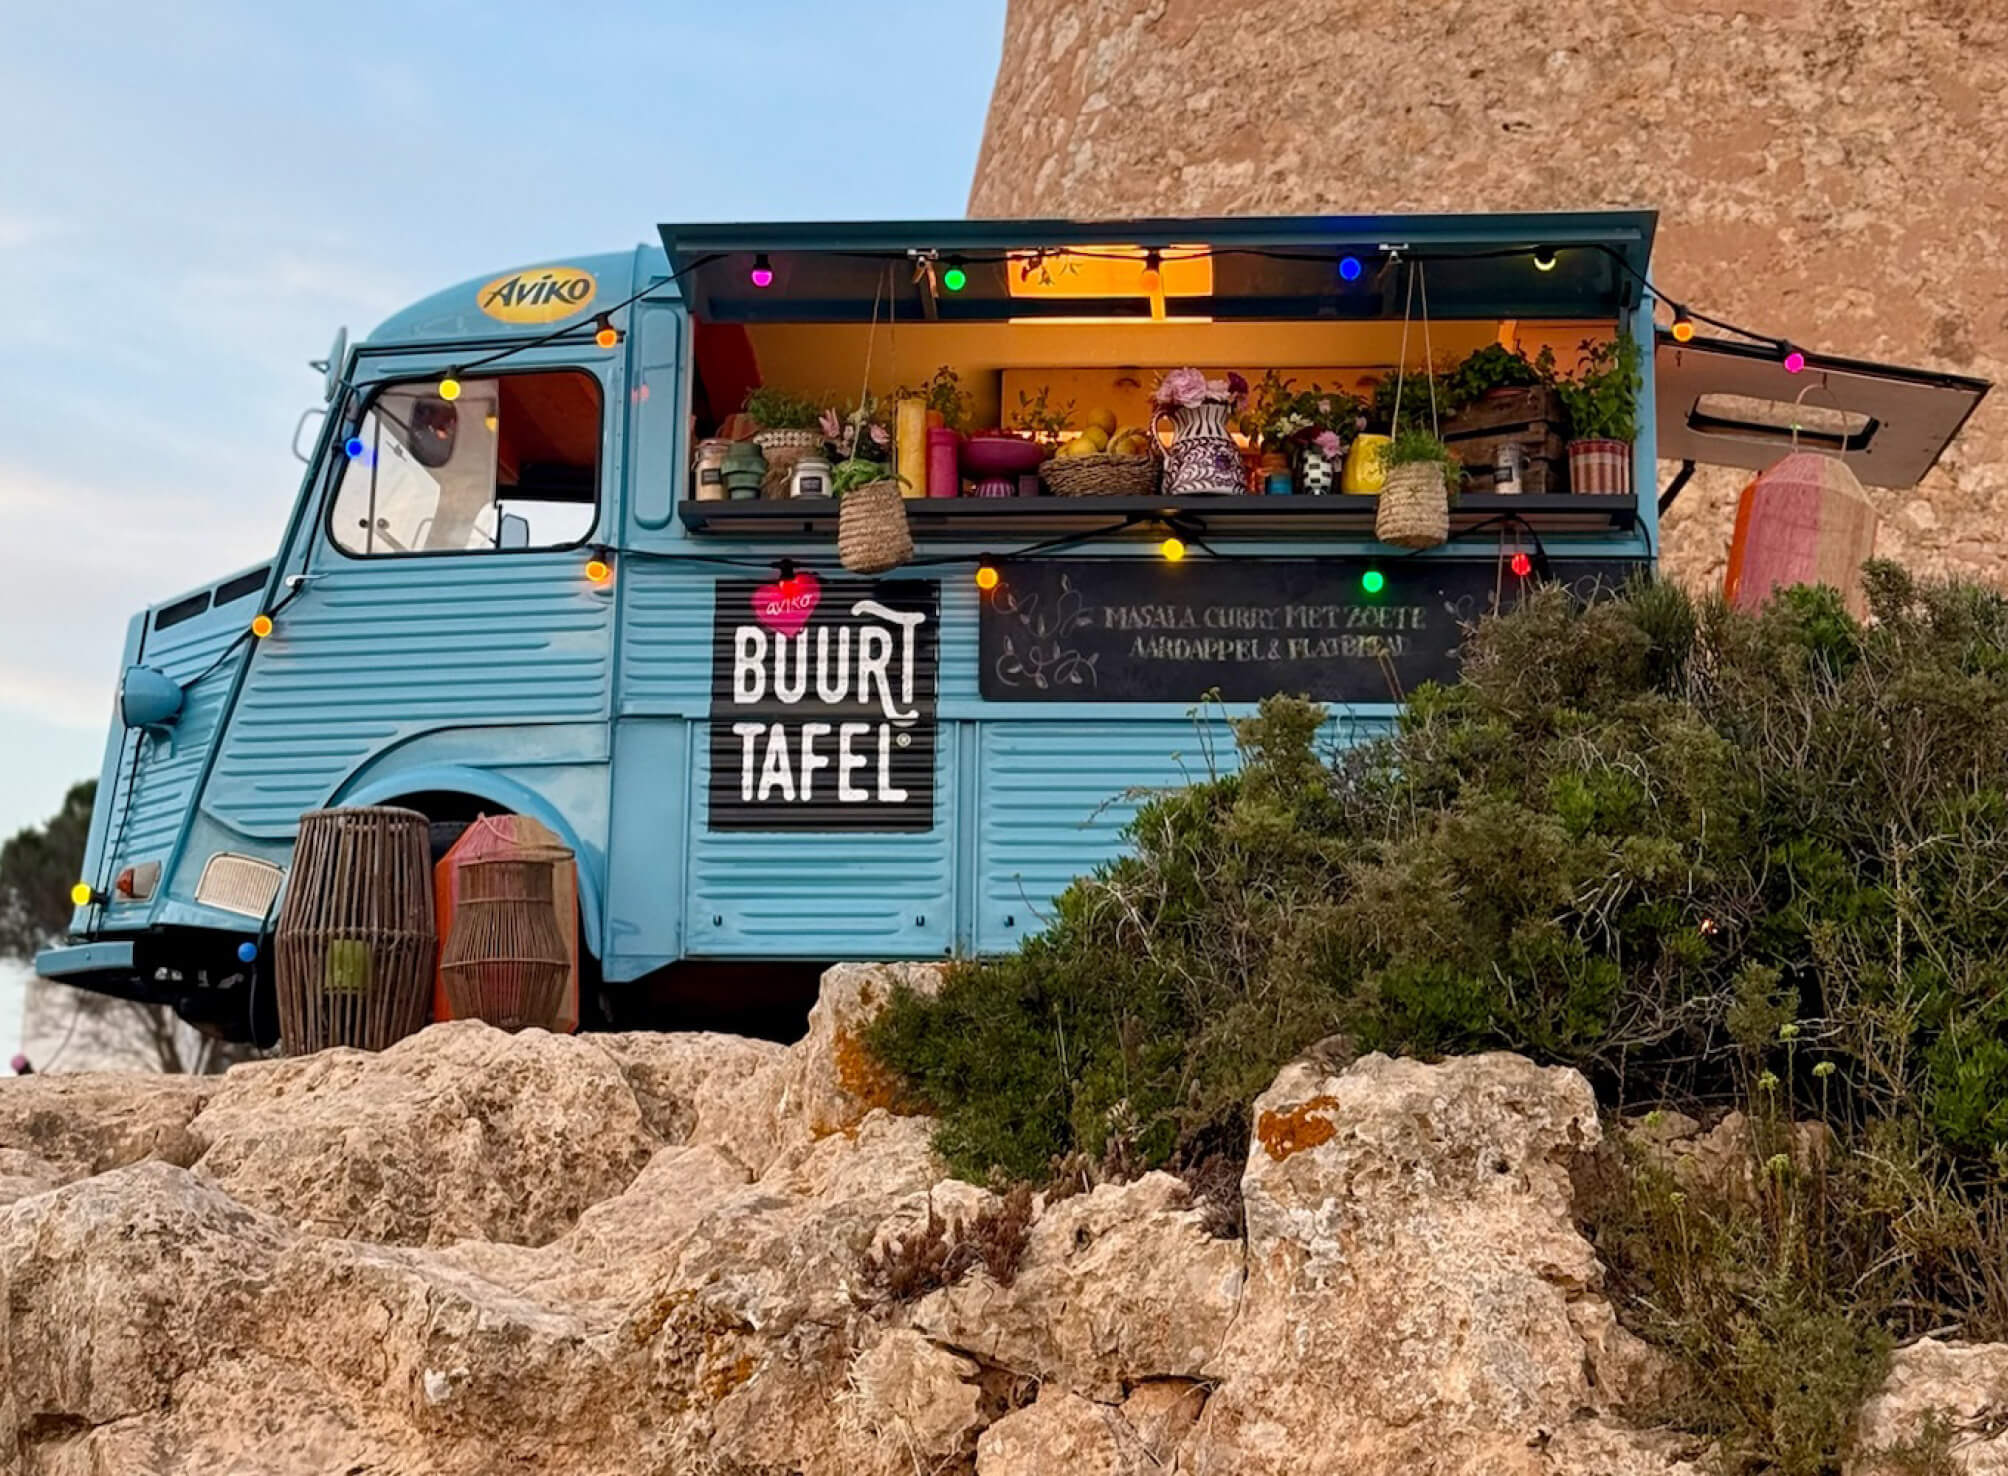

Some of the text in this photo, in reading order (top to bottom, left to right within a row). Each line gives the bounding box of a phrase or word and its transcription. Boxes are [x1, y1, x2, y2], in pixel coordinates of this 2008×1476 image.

[1103, 604, 1427, 630] MASALA CURRY MET ZOETE
[1129, 634, 1411, 661] AARDAPPEL & FLATBRAD
[733, 600, 926, 727] BUURT
